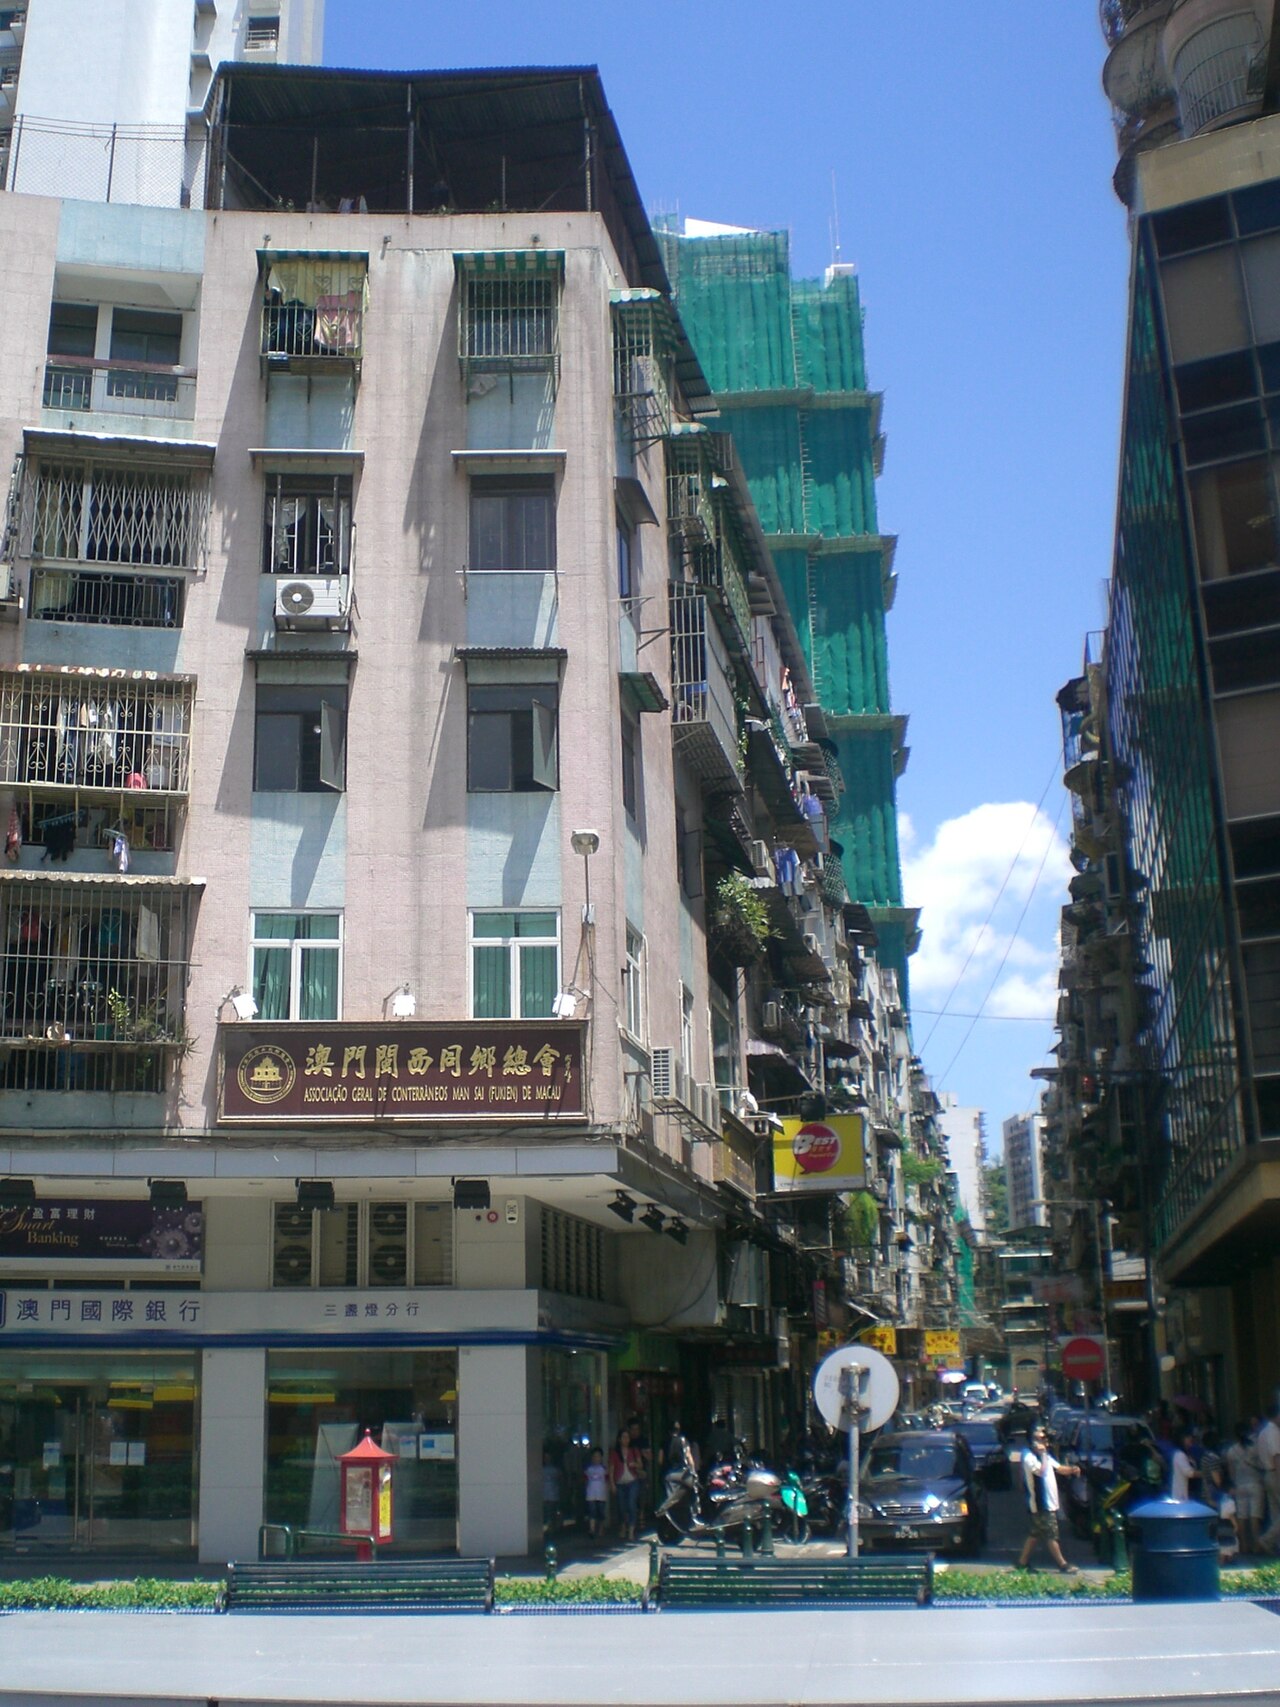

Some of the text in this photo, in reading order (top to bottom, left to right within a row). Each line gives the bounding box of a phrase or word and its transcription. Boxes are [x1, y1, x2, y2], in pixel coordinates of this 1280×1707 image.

[304, 1084, 348, 1104] ASSOCIAÇÃO
[352, 1086, 373, 1102] GERAL
[378, 1086, 387, 1102] DE
[452, 1087, 470, 1101] MAN
[474, 1086, 485, 1101] SAI
[488, 1086, 518, 1103] (FUKIEN)
[522, 1086, 532, 1101] DE
[535, 1085, 561, 1101] MACAU
[794, 1134, 837, 1154] BEST
[0, 1208, 55, 1233] Smart
[32, 1207, 95, 1220] 盈富理財
[27, 1231, 80, 1248] Banking
[16, 1298, 201, 1322] 澳門國際銀行
